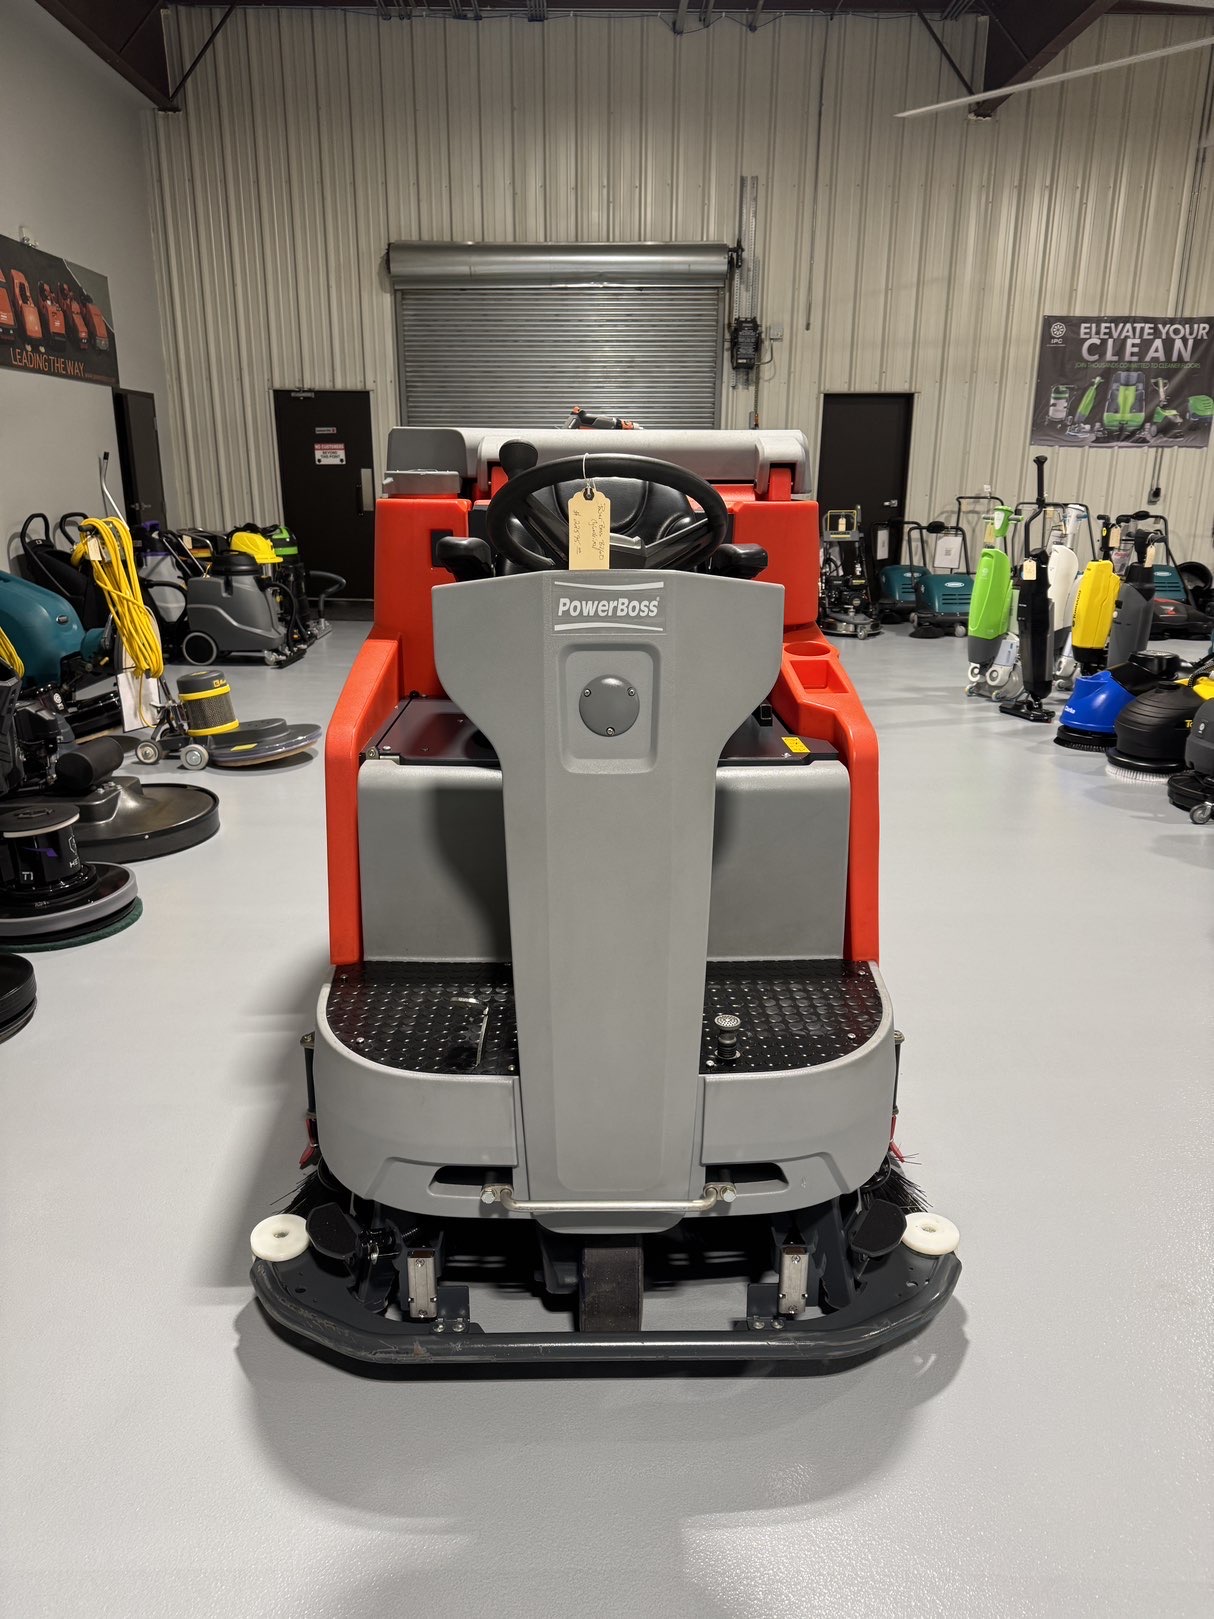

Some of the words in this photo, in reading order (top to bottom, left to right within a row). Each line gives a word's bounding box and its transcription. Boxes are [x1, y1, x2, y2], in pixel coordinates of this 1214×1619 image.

[1080, 323, 1154, 339] ELEVATE
[1157, 323, 1210, 340] YOUR
[1082, 338, 1194, 362] CLEAN
[10, 347, 49, 371] LEADING
[49, 356, 66, 374] THE
[66, 360, 85, 377] WAY
[558, 597, 659, 617] PowerBoss
